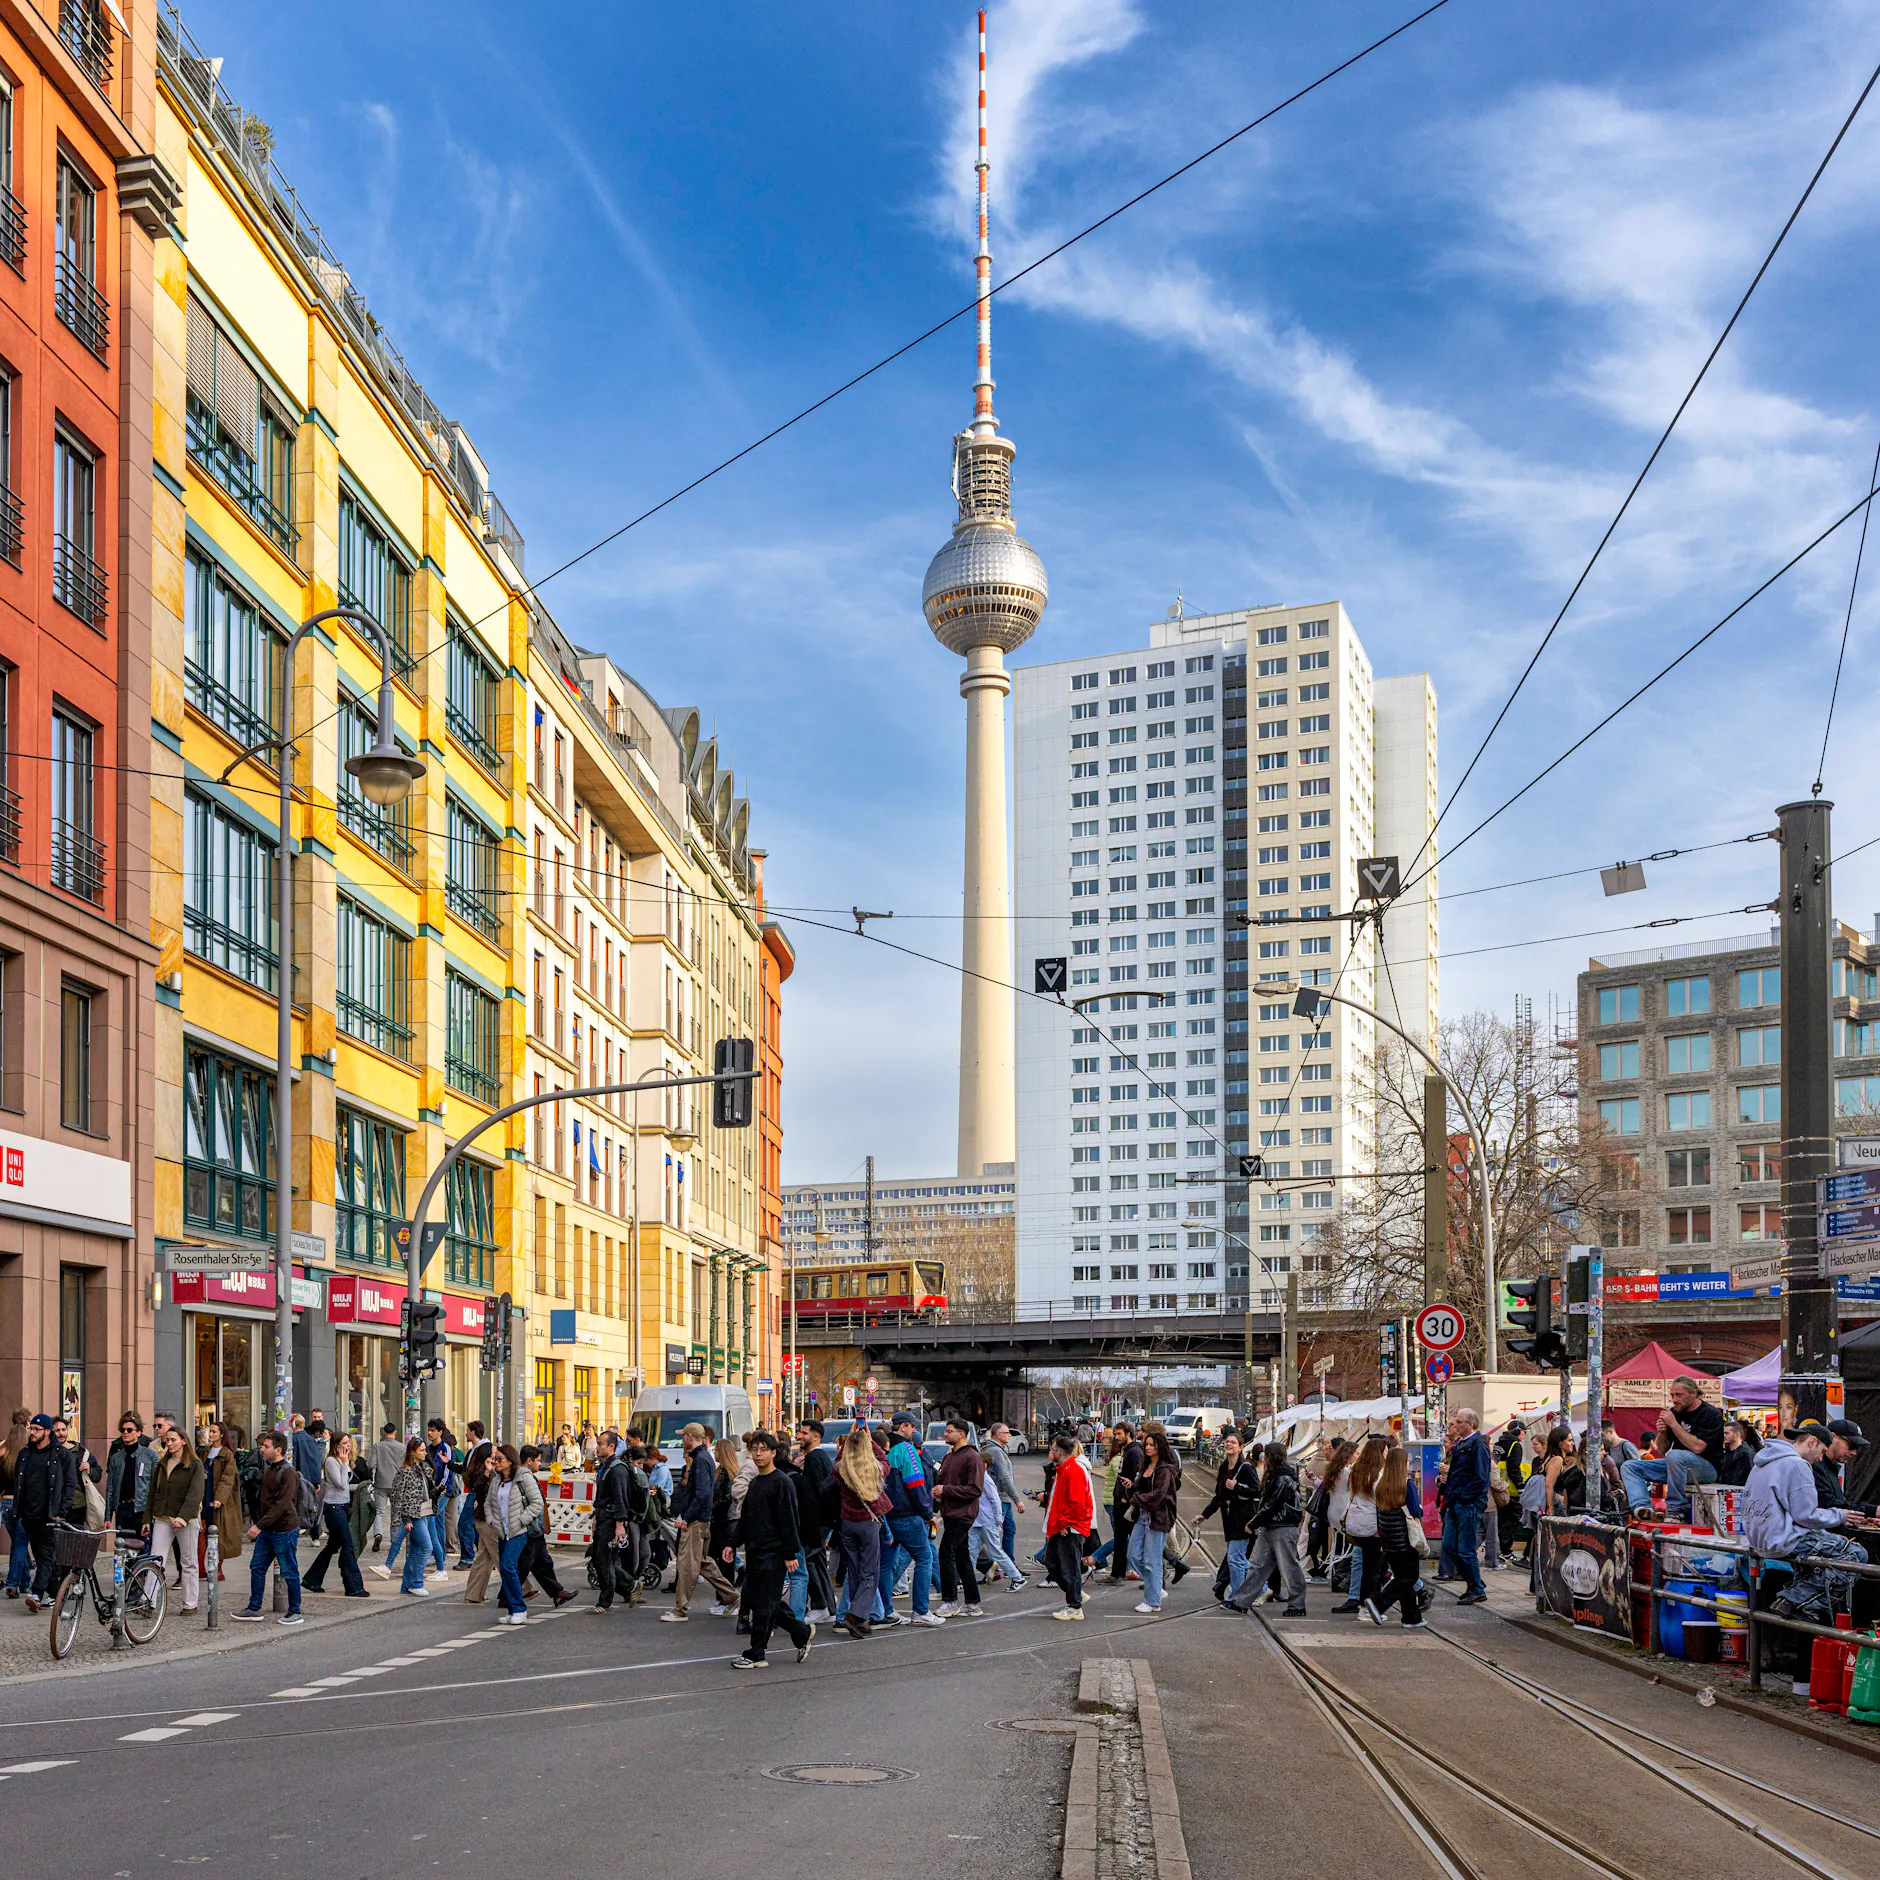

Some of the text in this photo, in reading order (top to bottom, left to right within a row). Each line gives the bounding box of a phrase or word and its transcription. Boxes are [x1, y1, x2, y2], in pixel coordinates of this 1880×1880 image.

[1851, 1143, 1880, 1158] Neu
[8, 1152, 22, 1167] UNI
[8, 1168, 23, 1182] QLO
[173, 1252, 230, 1264] Rosenthaler
[1830, 1249, 1867, 1267] Hackescher
[1770, 1261, 1780, 1276] Ma
[1624, 1283, 1658, 1294] S-BAHN
[1660, 1282, 1690, 1292] GEHT'S
[1692, 1280, 1727, 1291] WEITER
[332, 1293, 353, 1303] MUJI
[361, 1288, 380, 1313] MUJI
[462, 1306, 477, 1328] MUJI
[1426, 1316, 1454, 1338] 30
